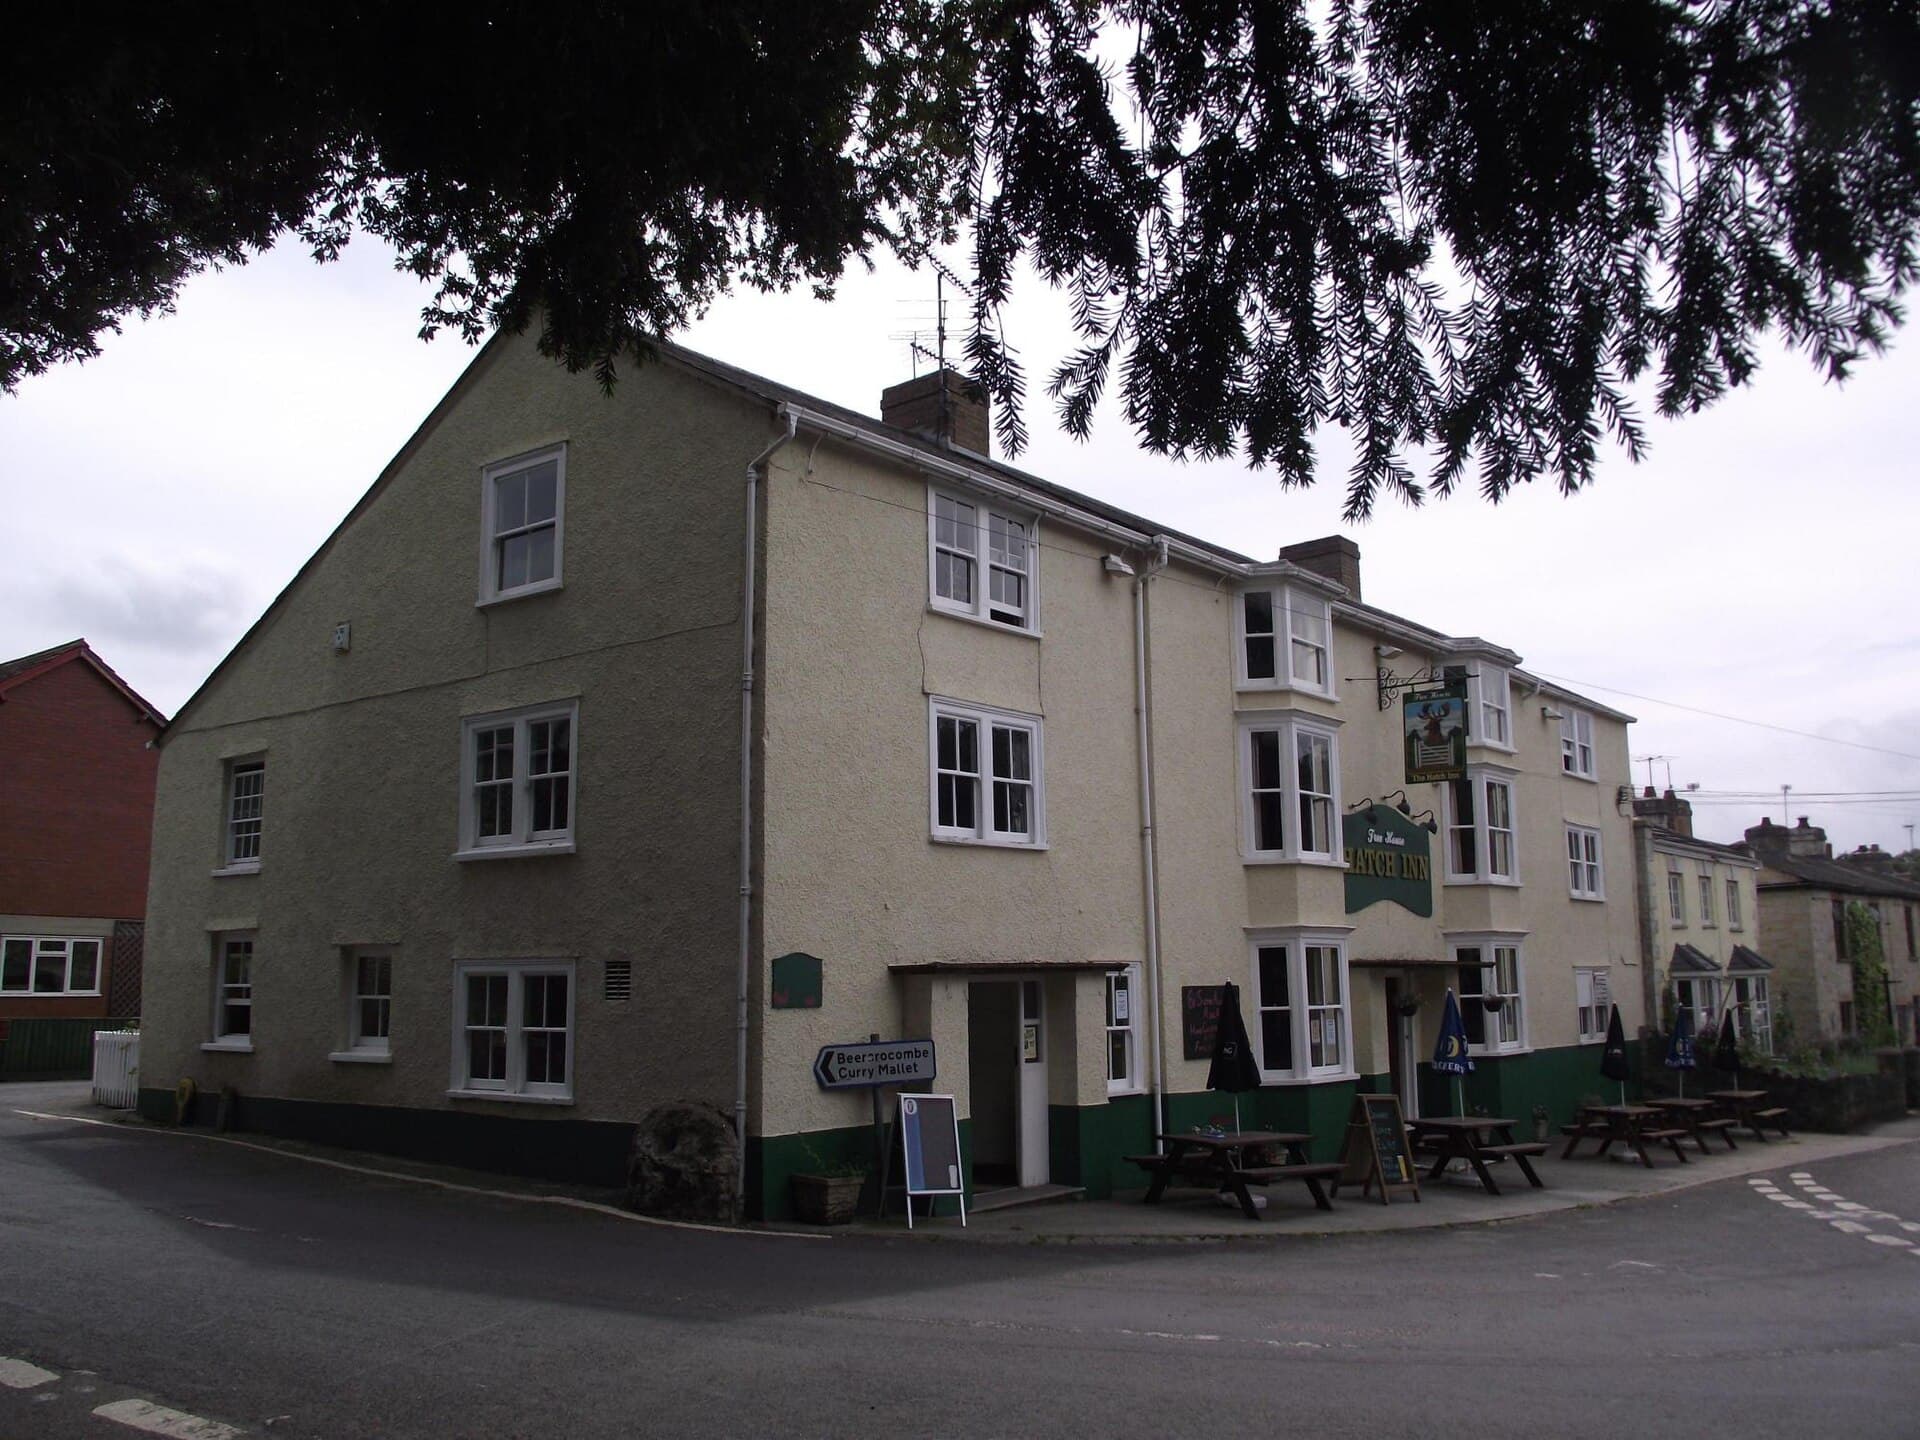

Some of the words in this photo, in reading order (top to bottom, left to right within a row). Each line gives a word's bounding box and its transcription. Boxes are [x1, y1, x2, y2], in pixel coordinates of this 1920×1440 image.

[1343, 847, 1397, 878] HATCH
[1401, 853, 1429, 881] INN
[838, 1066, 874, 1079] Curry
[878, 1062, 919, 1076] Mallet
